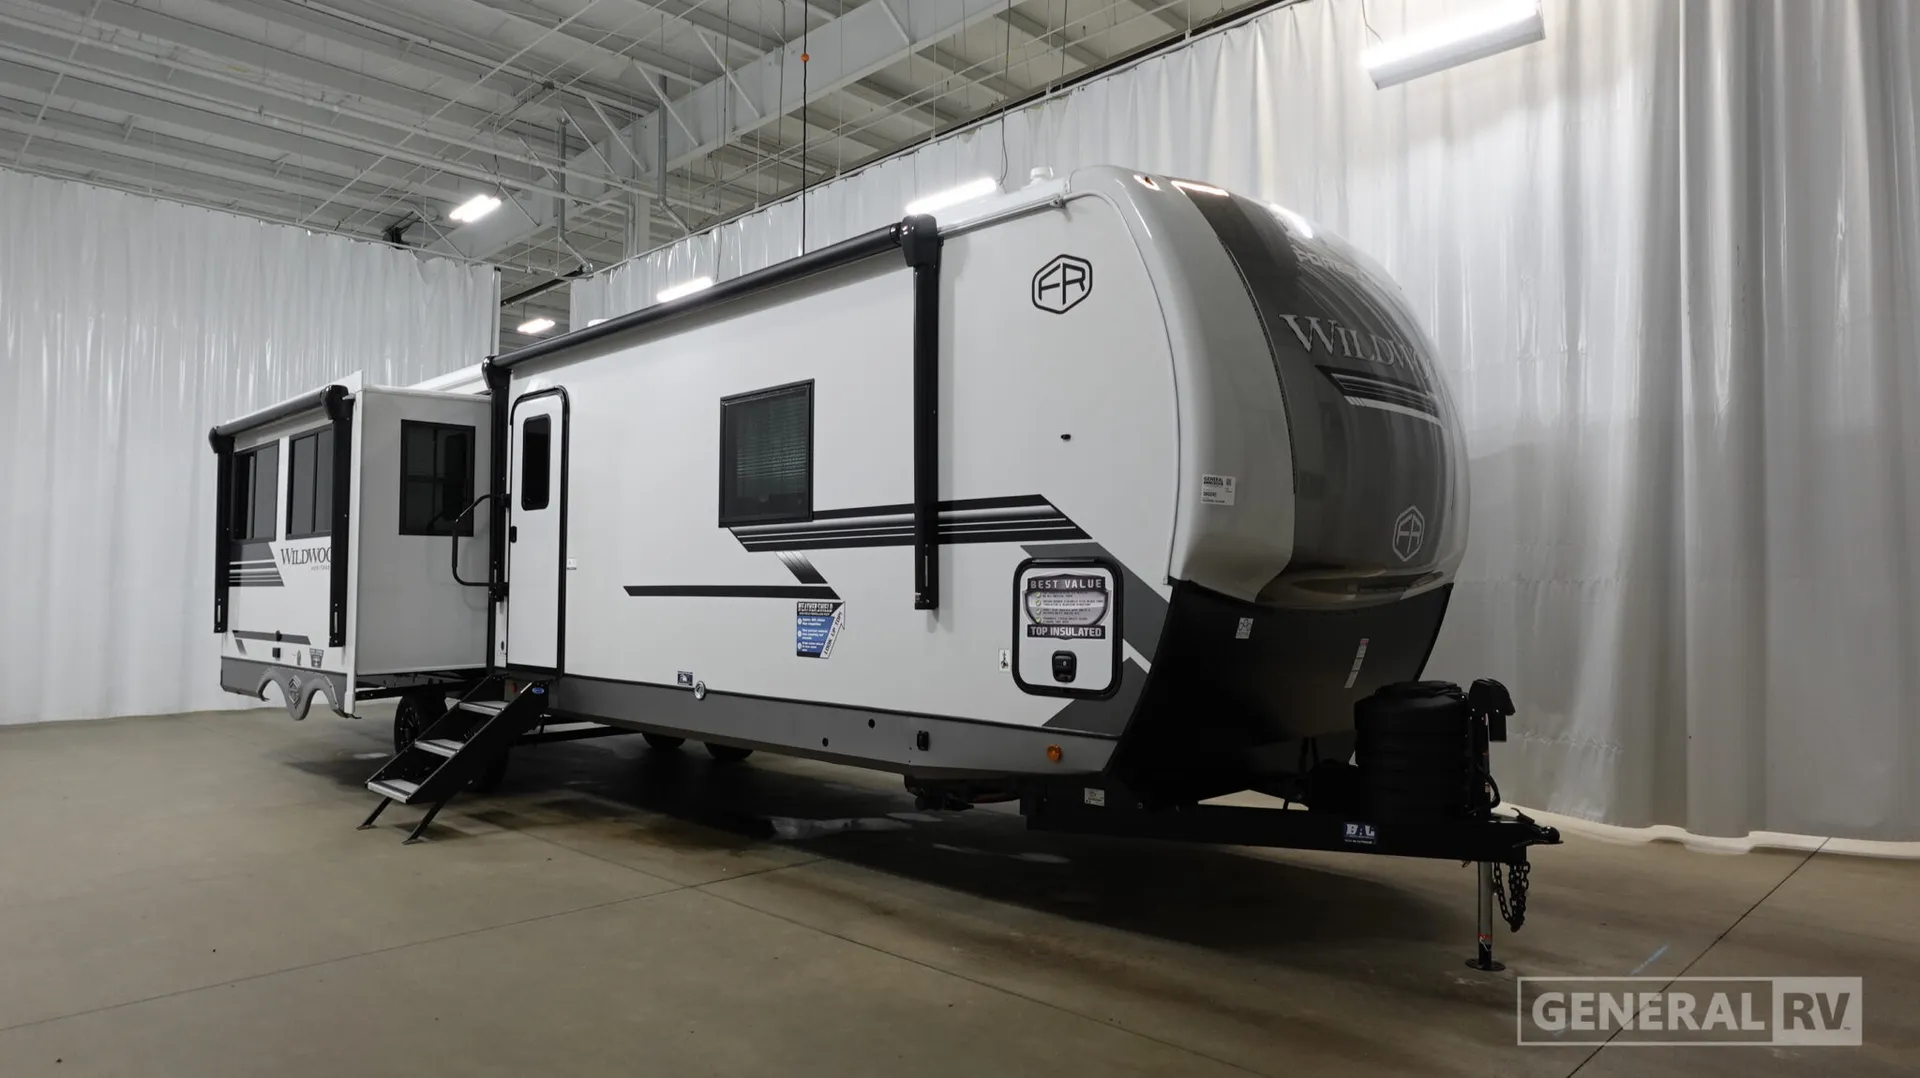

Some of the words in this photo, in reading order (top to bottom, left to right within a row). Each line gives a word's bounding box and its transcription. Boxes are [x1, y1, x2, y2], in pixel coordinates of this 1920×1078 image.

[1037, 261, 1087, 306] FR
[1030, 580, 1059, 589] BEST
[1064, 579, 1102, 589] VALUE
[824, 638, 832, 654] LOOK
[831, 627, 836, 637] UP
[1031, 626, 1048, 636] TOP
[1050, 627, 1102, 637] INSULATED
